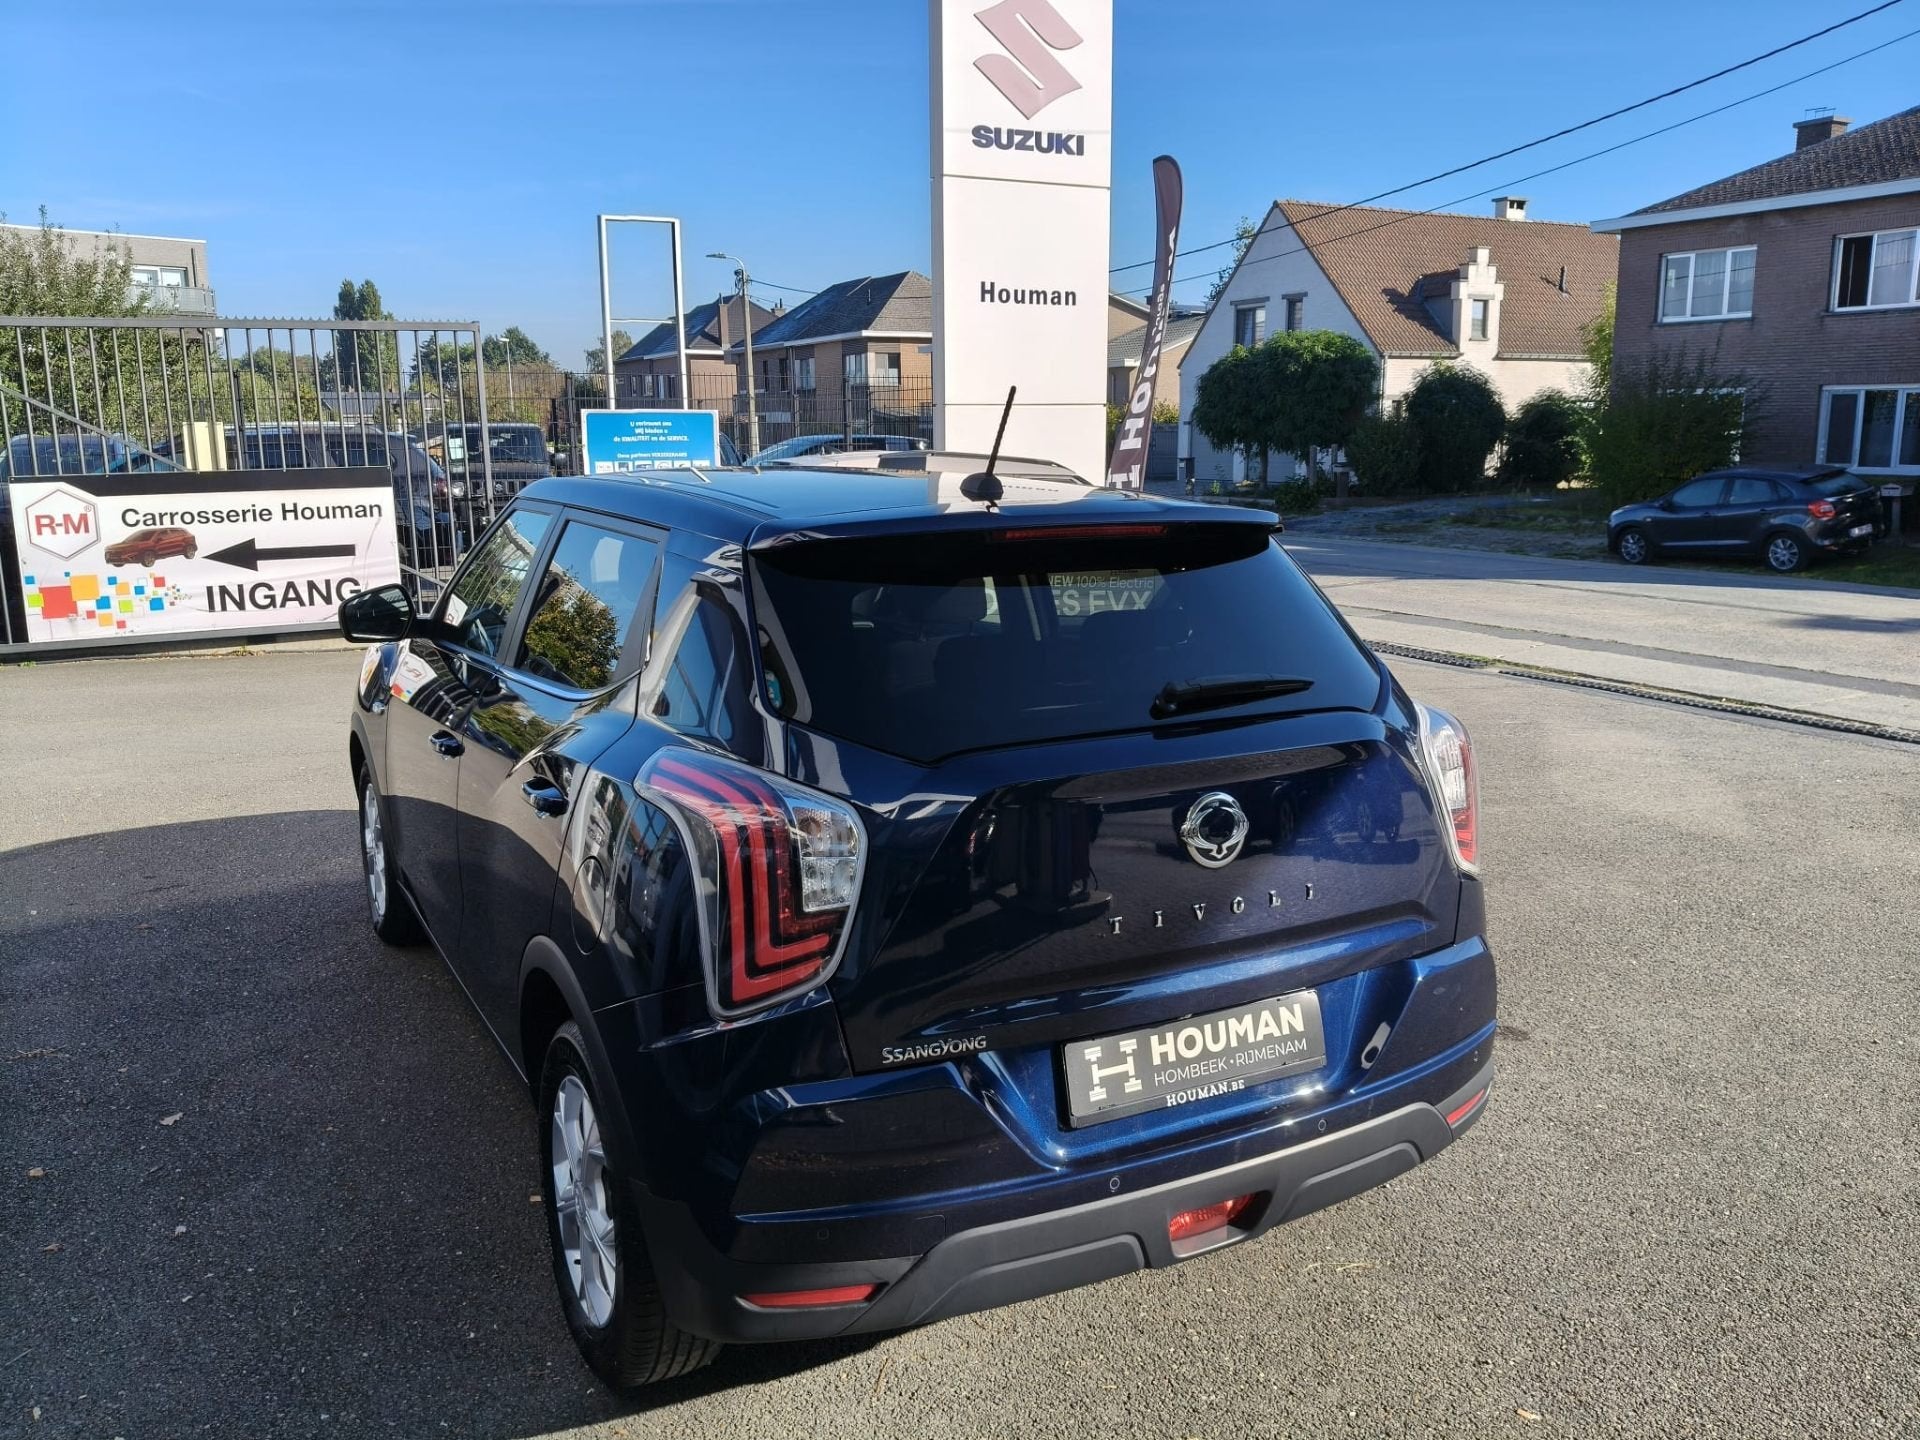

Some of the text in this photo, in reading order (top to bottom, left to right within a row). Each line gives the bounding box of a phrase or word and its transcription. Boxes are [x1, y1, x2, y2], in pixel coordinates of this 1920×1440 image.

[971, 125, 1084, 156] SUZUKI
[980, 281, 1077, 306] Houman
[121, 503, 382, 527] Carrosserie Houman
[206, 577, 361, 613] INGANG
[1076, 575, 1105, 588] 100%
[1109, 576, 1154, 588] Electric
[1109, 882, 1314, 935] TIVOLI
[1150, 1003, 1305, 1066] HOUMAN
[1154, 1037, 1307, 1087] HOMBEEK RIJMENAM
[1166, 1079, 1245, 1107] HOUMAN.BE
